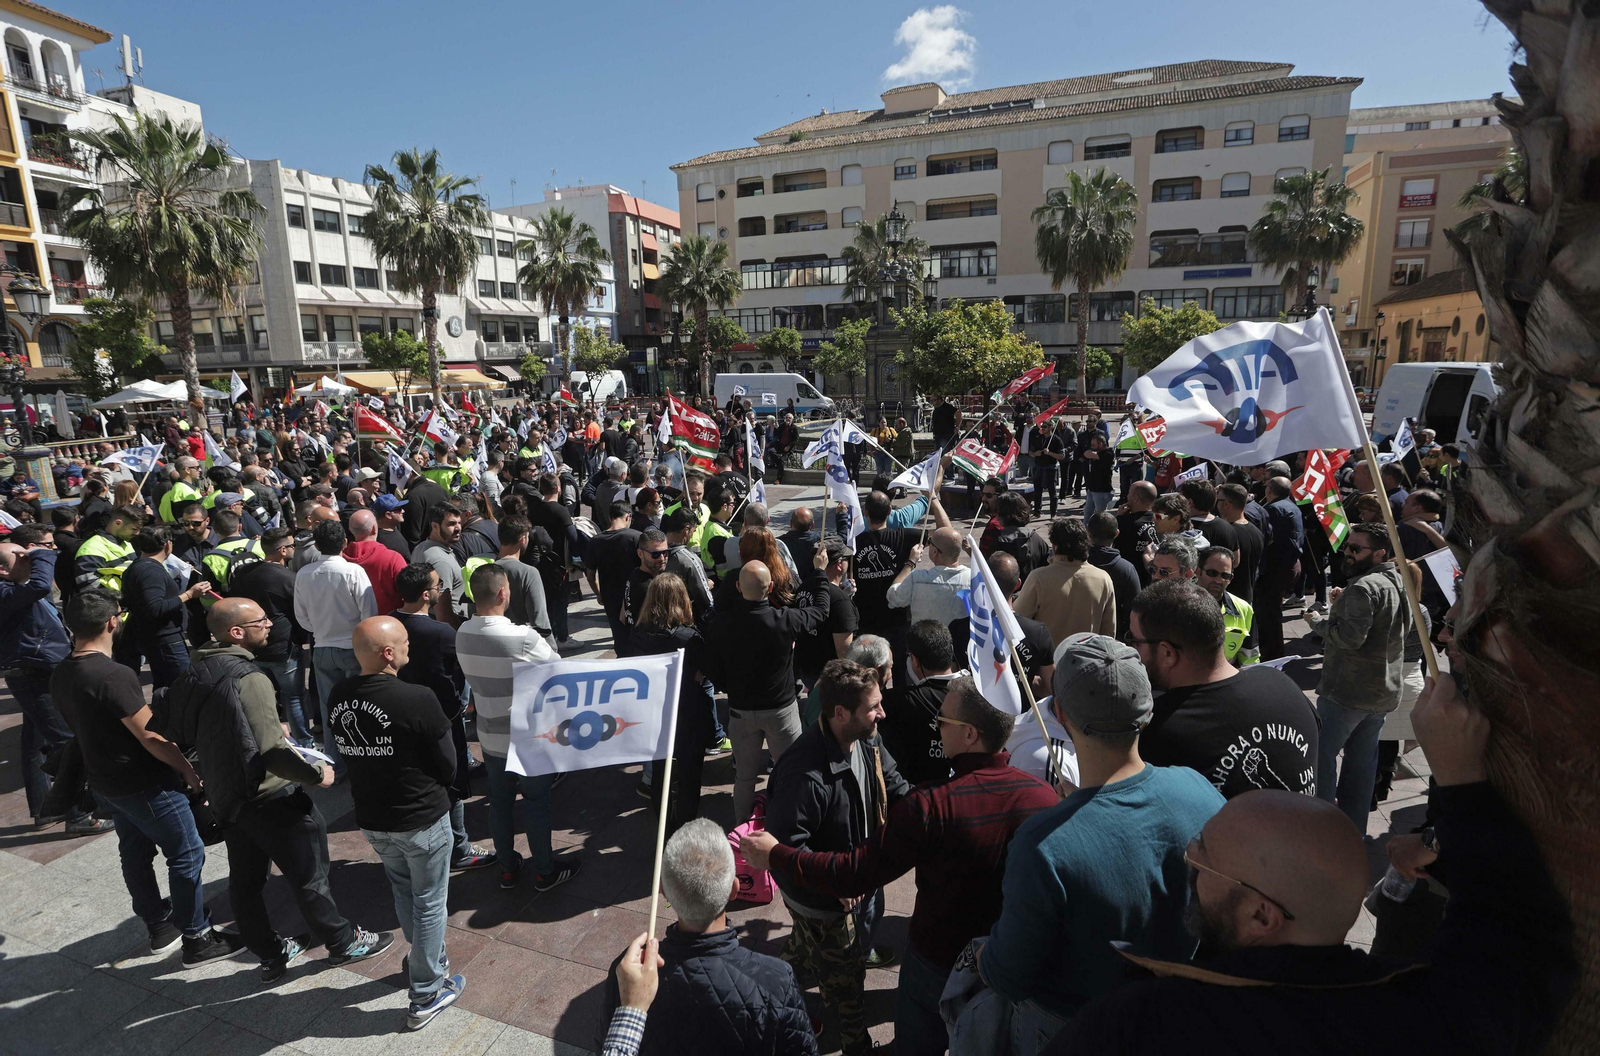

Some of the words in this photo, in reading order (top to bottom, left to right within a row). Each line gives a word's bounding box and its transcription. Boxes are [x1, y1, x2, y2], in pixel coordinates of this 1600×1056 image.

[1168, 339, 1298, 401] ATA
[856, 545, 874, 562] AHORA
[532, 668, 650, 714] ATA
[352, 699, 359, 709] O
[360, 700, 392, 729] NUNCA
[365, 745, 394, 757] DIGNO
[375, 736, 392, 745] UN
[1212, 735, 1251, 793] AHORA
[1251, 726, 1263, 743] O
[1266, 723, 1309, 758] NUNCA
[1299, 766, 1314, 785] UN
